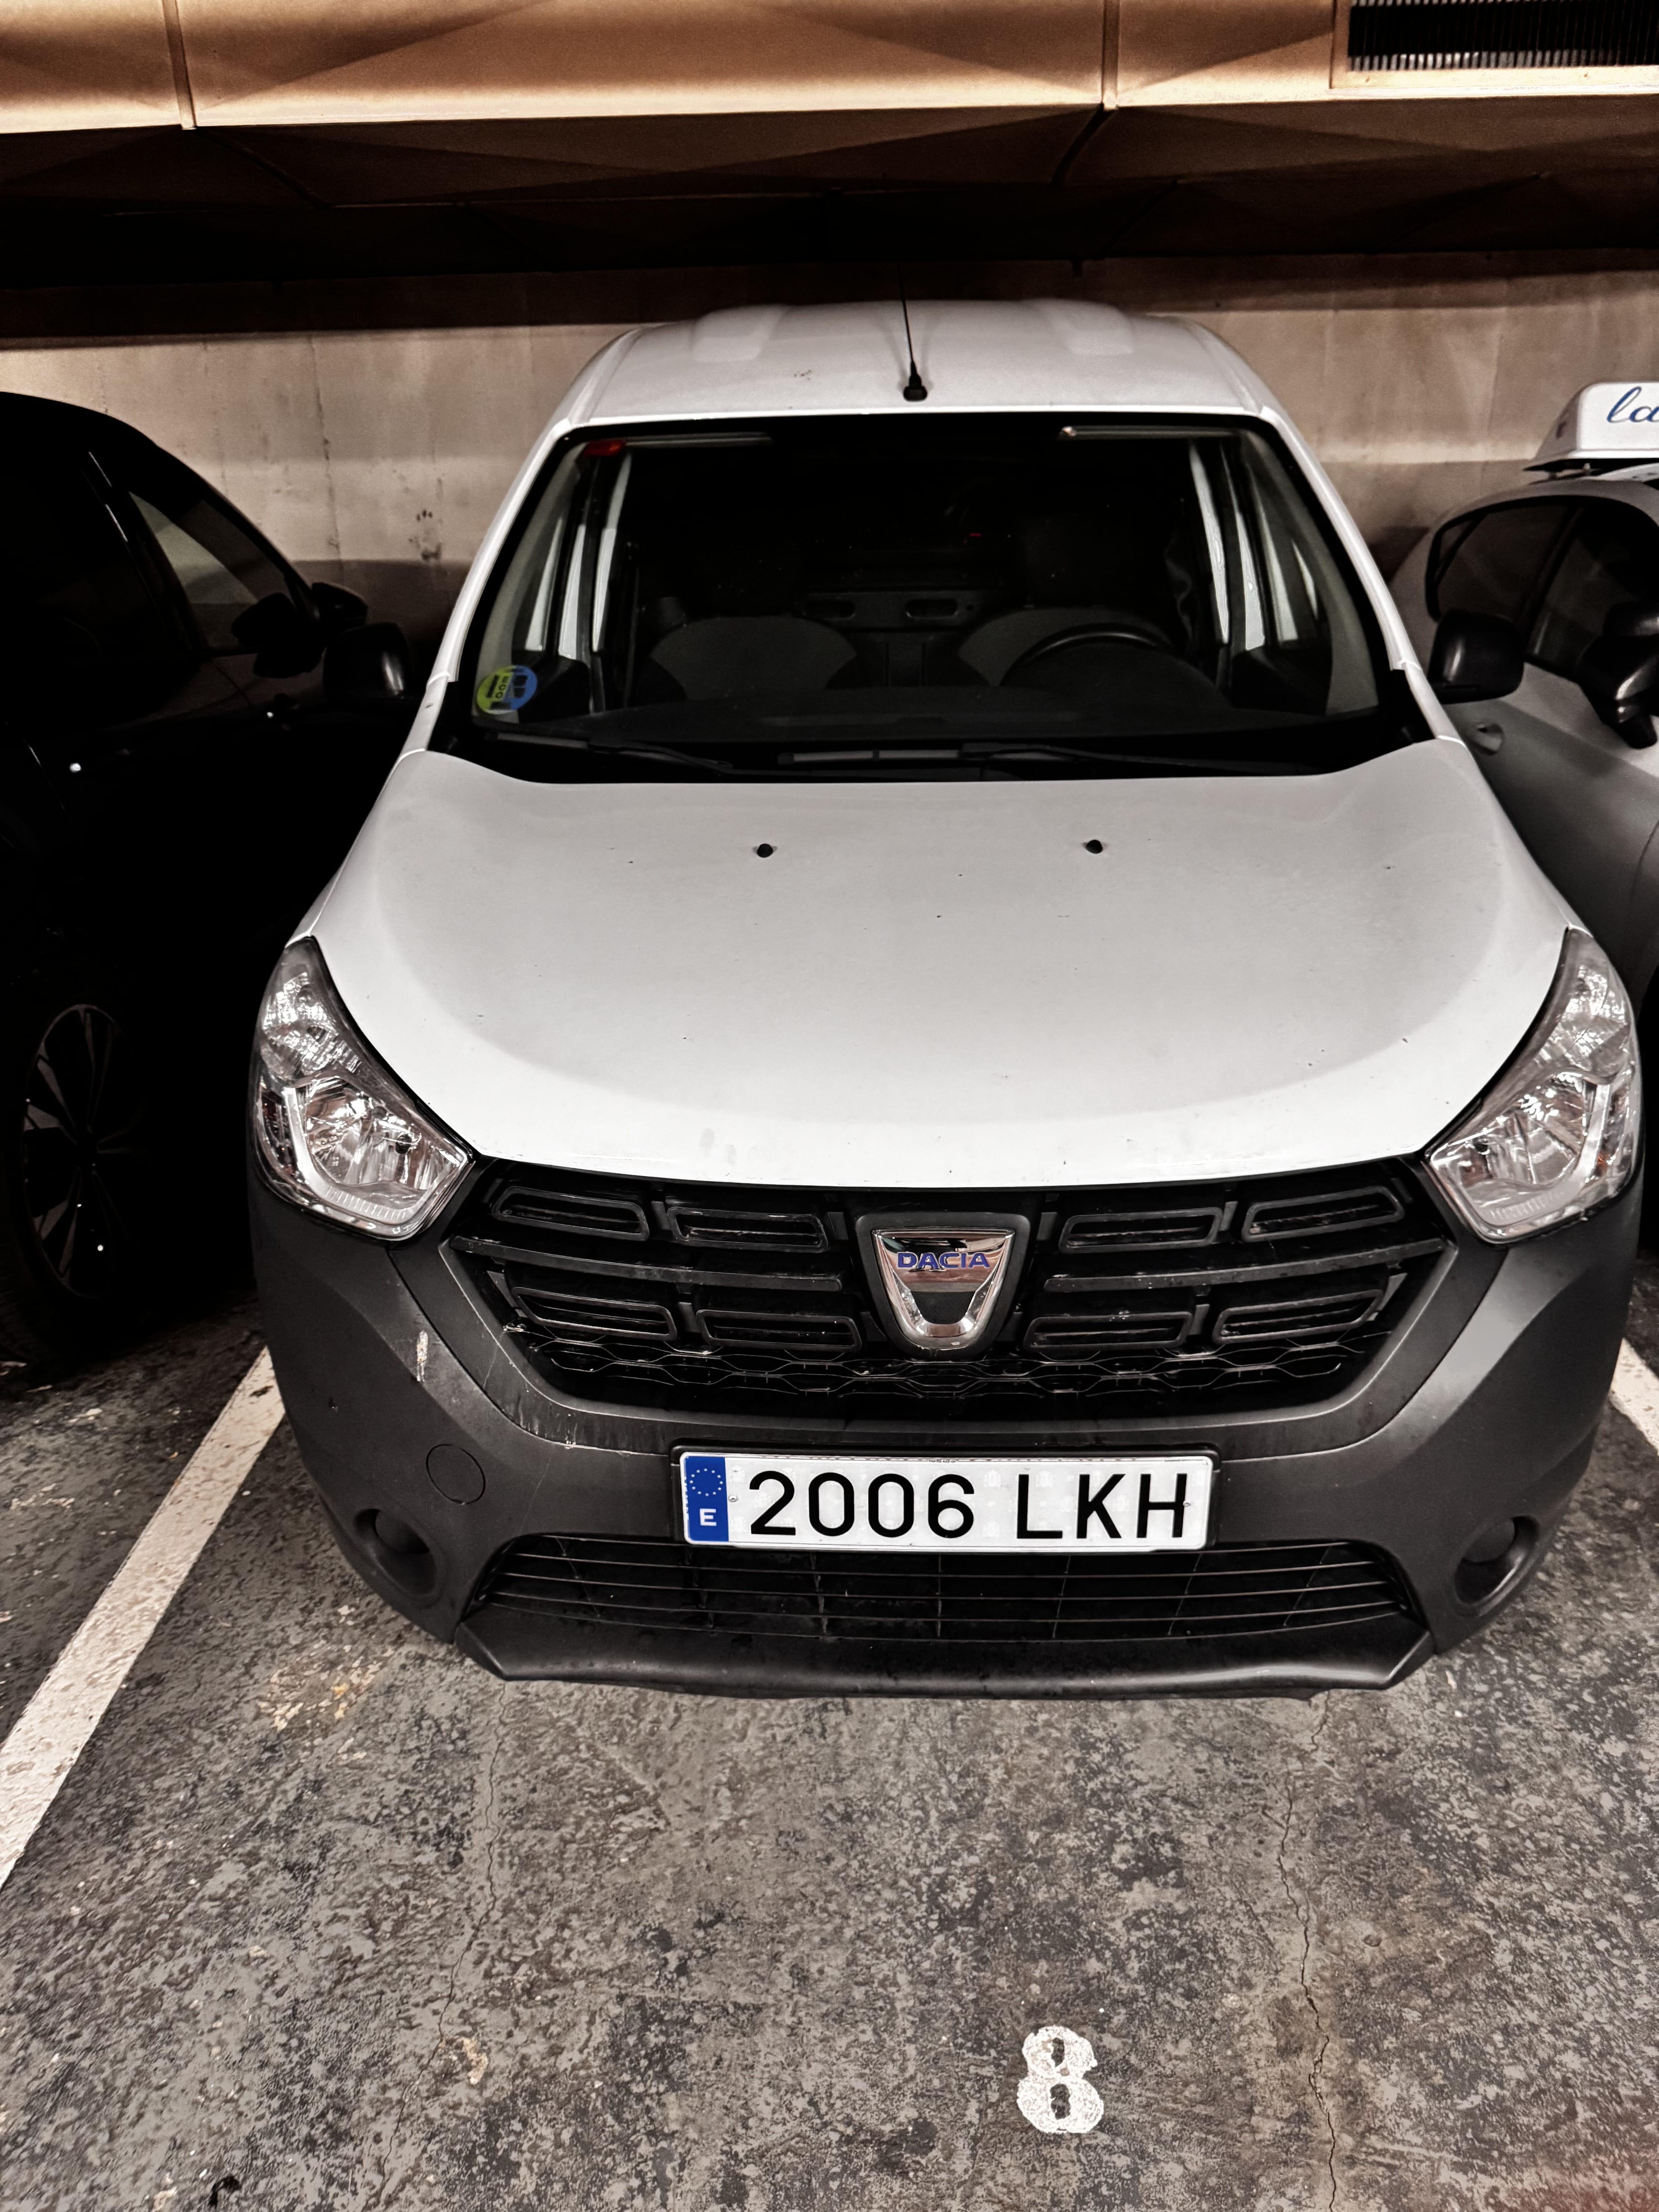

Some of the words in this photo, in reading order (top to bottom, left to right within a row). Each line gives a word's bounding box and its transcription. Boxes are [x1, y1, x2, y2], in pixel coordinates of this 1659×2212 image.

[897, 1252, 990, 1269] DACIA
[699, 1508, 717, 1526] E
[749, 1470, 974, 1539] 2006
[1017, 1474, 1187, 1539] LKH
[1017, 2025, 1104, 2134] 8
